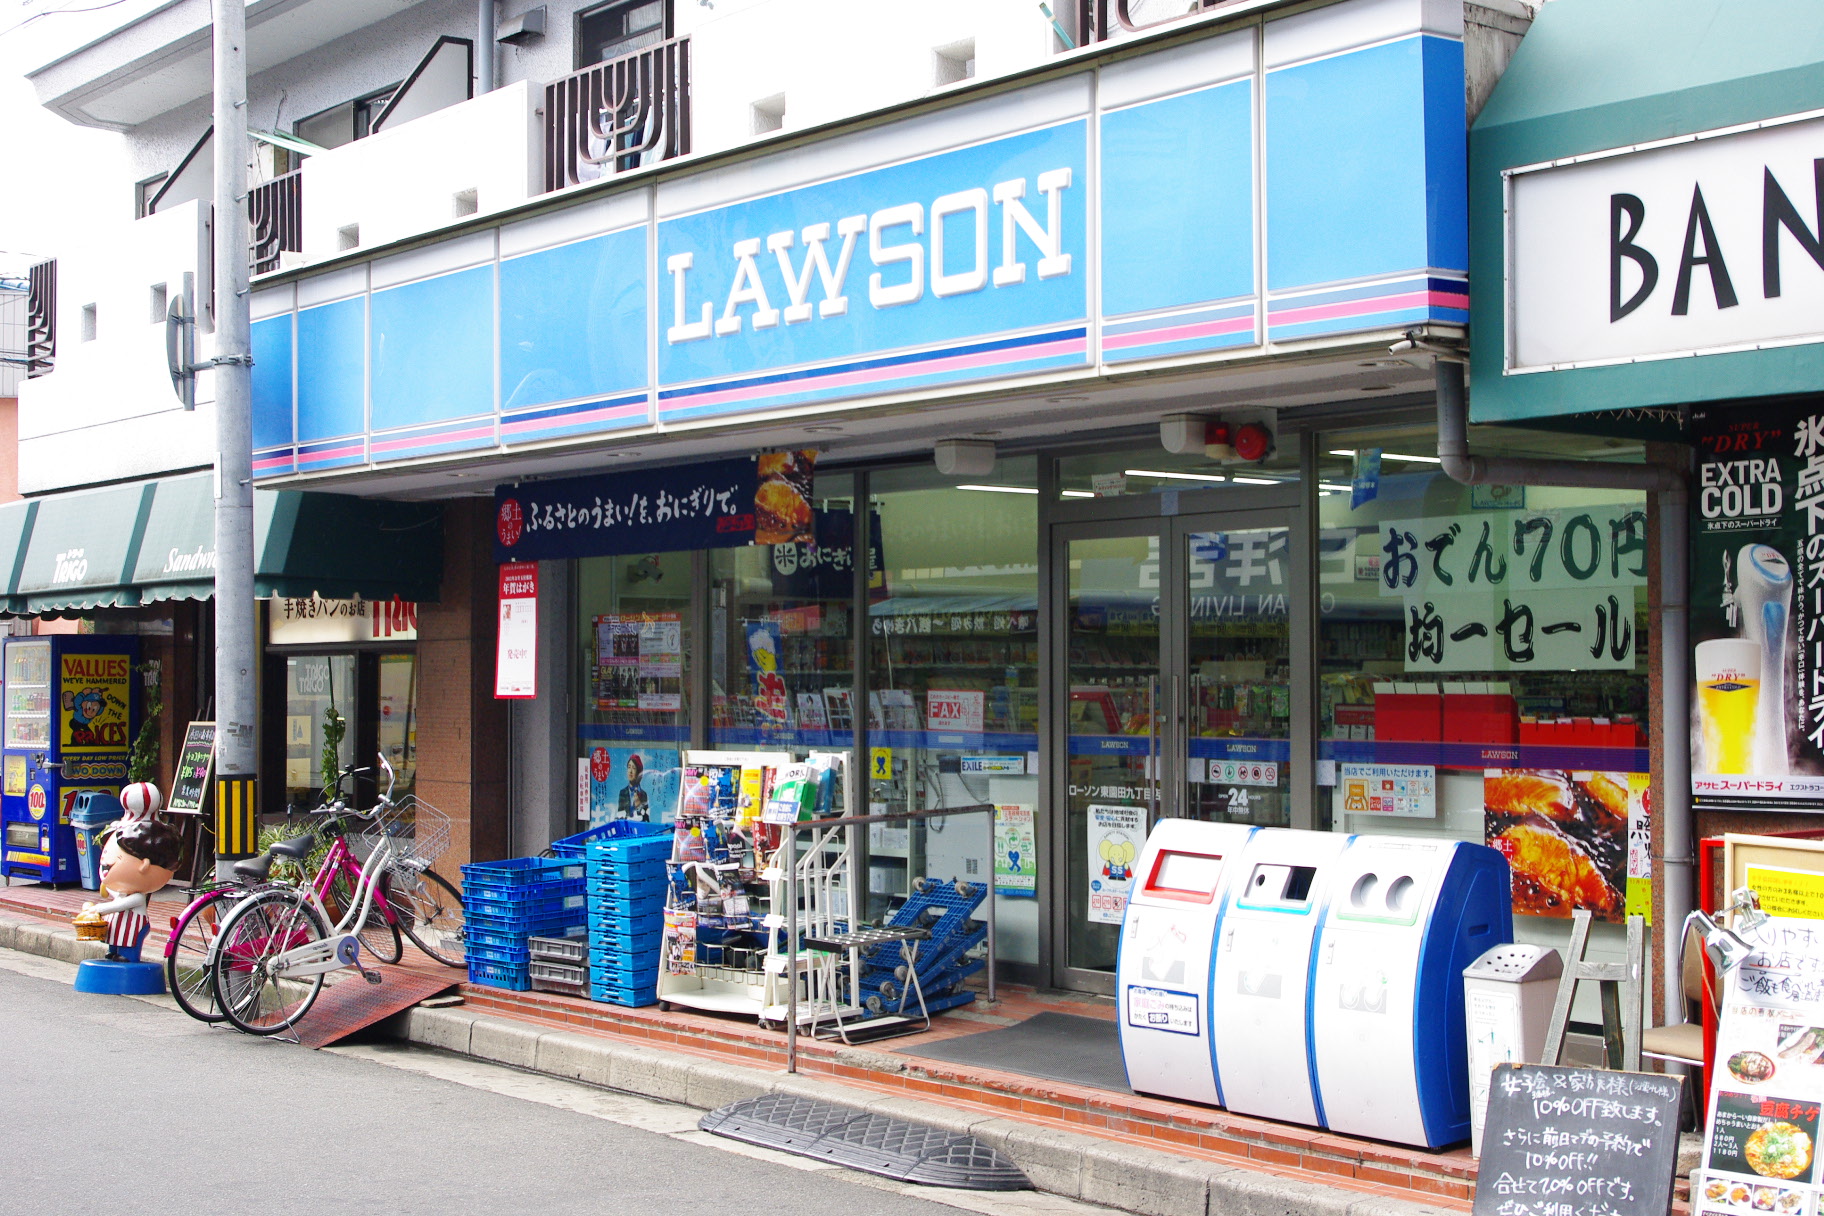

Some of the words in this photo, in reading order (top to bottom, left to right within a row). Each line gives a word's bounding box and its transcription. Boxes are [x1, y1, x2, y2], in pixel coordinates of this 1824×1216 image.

[667, 167, 1072, 345] LAWSON
[1702, 458, 1782, 487] EXTRA
[1701, 483, 1783, 518] COLD
[1707, 518, 1777, 530] 氷点下のスーパードライ
[1383, 510, 1648, 597] おでん70円
[52, 552, 87, 583] TRIGO
[503, 581, 535, 595] 年賀はがき
[284, 597, 366, 620] 手焼きパンのお店
[1408, 594, 1631, 662] 均一セール
[63, 658, 128, 678] VALUES
[86, 677, 127, 685] HAMMERED
[106, 693, 127, 710] DOWN
[108, 708, 122, 720] THE
[930, 702, 960, 719] FAX
[73, 721, 126, 745] PRICES
[1101, 741, 1129, 749] LAWSON
[1226, 744, 1257, 753] LAWSON
[1481, 750, 1519, 760] LAWSON
[92, 767, 125, 776] DOWN
[685, 768, 698, 777] HMV
[961, 761, 983, 771] EXILE
[1344, 766, 1433, 779] 当店でご利用いただけます。
[1228, 788, 1249, 807] 24
[1227, 806, 1250, 814] 年中無休
[1492, 838, 1513, 852] 郷土
[1111, 866, 1124, 875] SS
[1501, 1071, 1549, 1096] 女子会
[1760, 1099, 1821, 1122] 豆腐チゲ
